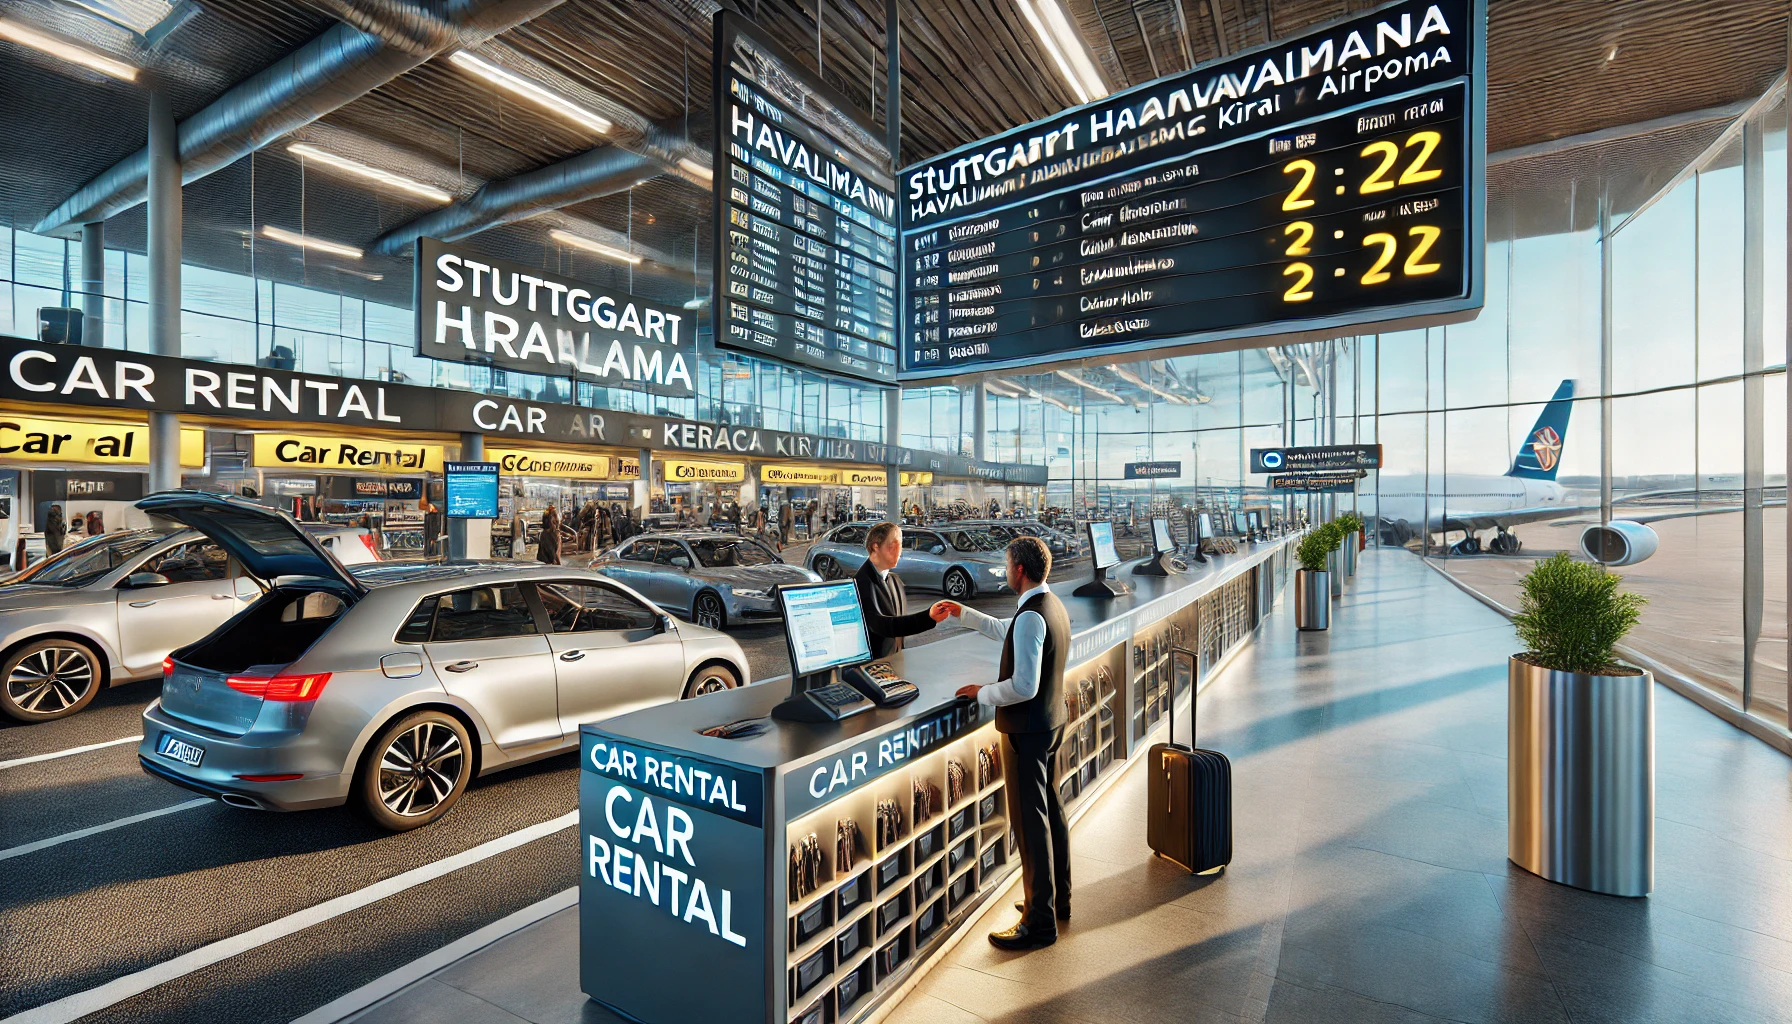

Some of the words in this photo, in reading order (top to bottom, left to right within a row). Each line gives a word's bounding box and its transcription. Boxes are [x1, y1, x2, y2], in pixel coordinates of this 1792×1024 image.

[436, 253, 683, 346] STUTTGGART
[9, 349, 156, 403] CAR
[185, 368, 401, 423] RENTAL
[472, 399, 548, 434] CAR
[0, 422, 72, 455] Car
[275, 439, 332, 464] Car
[590, 742, 638, 781] CAR
[644, 755, 747, 813] RENTAL
[808, 750, 868, 799] CAR
[604, 785, 696, 867] CAR
[588, 833, 747, 949] RENTAL
